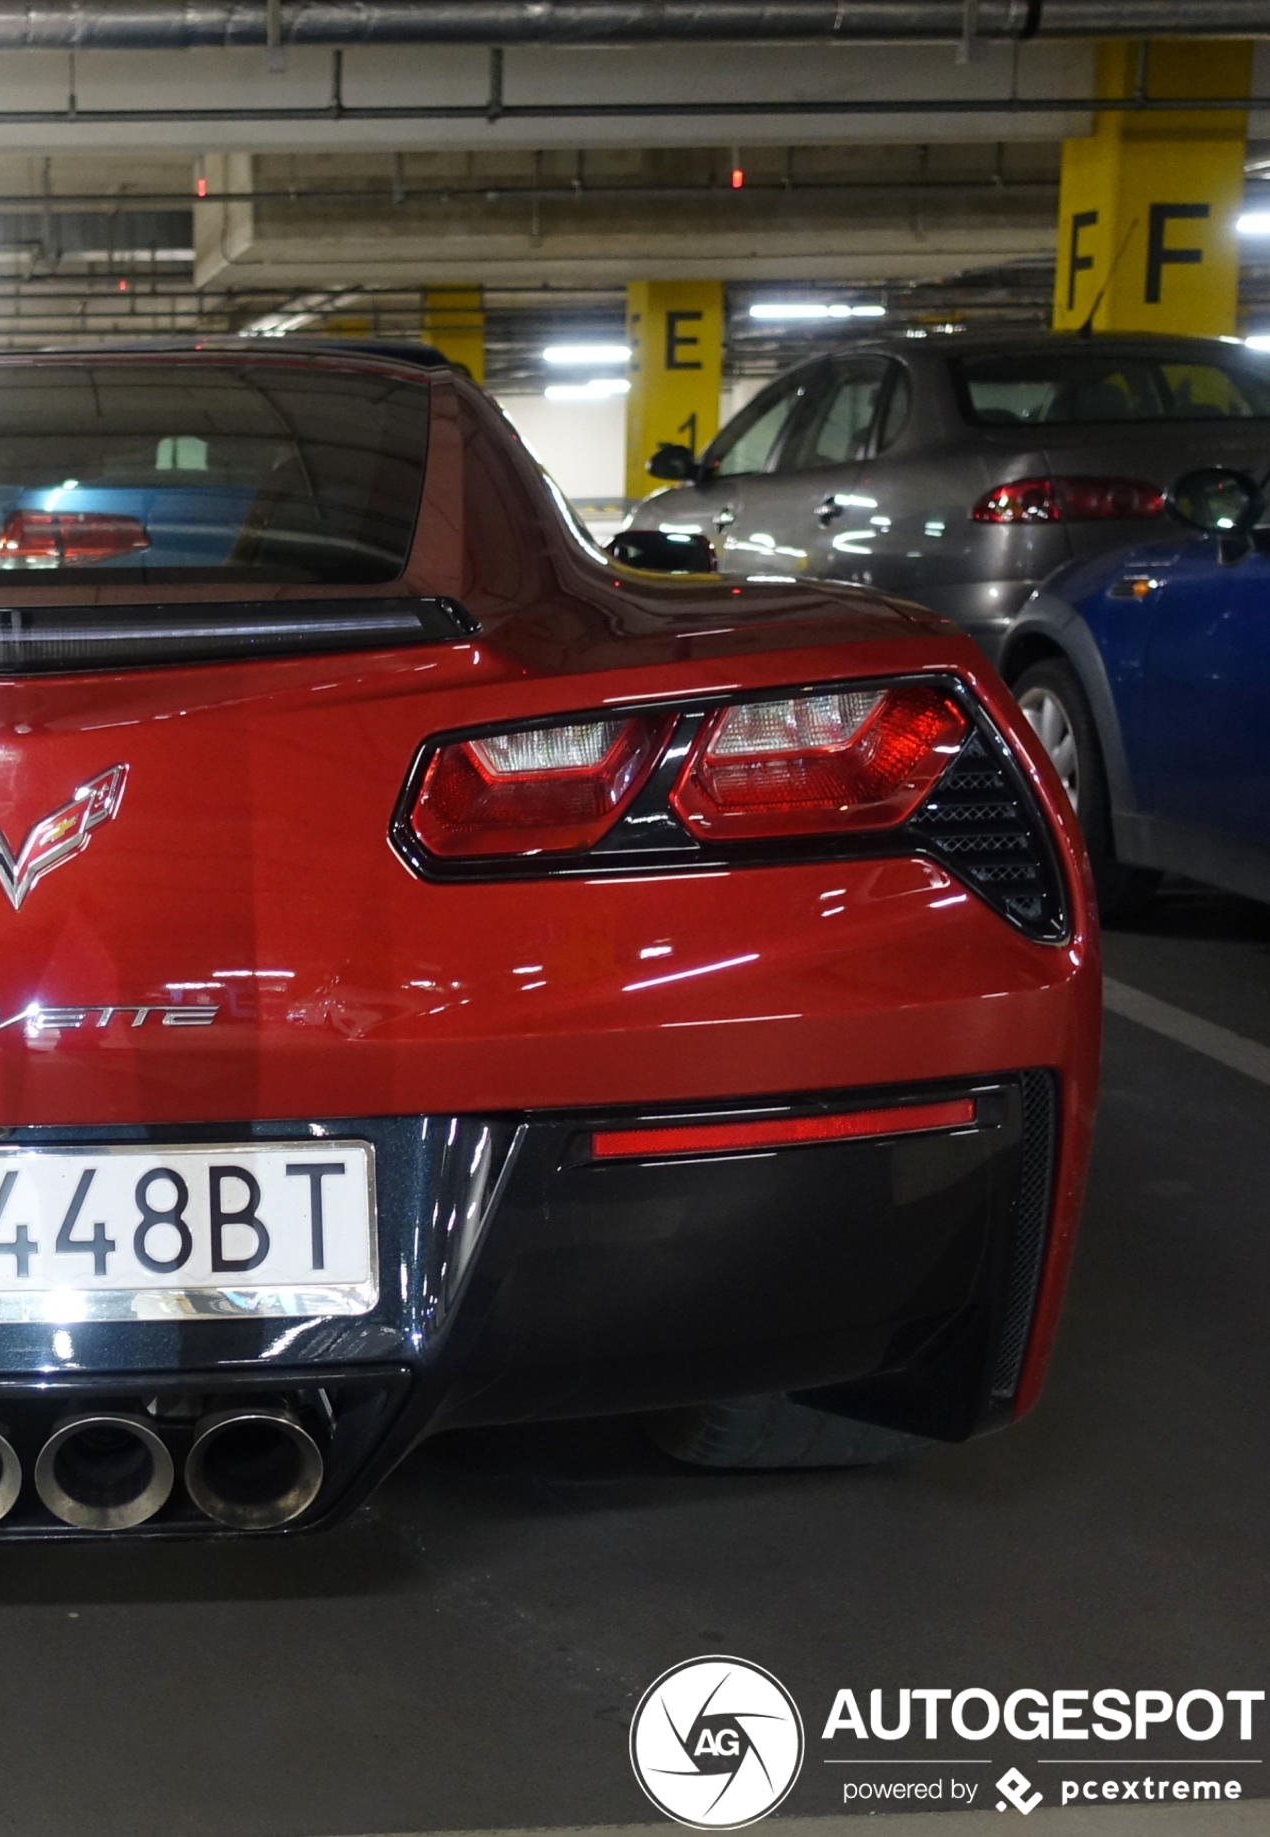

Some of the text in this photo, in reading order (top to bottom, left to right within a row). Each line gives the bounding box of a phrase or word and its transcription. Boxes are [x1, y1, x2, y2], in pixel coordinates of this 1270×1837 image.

[1067, 211, 1098, 310] F
[1144, 203, 1209, 303] F
[666, 312, 702, 369] E
